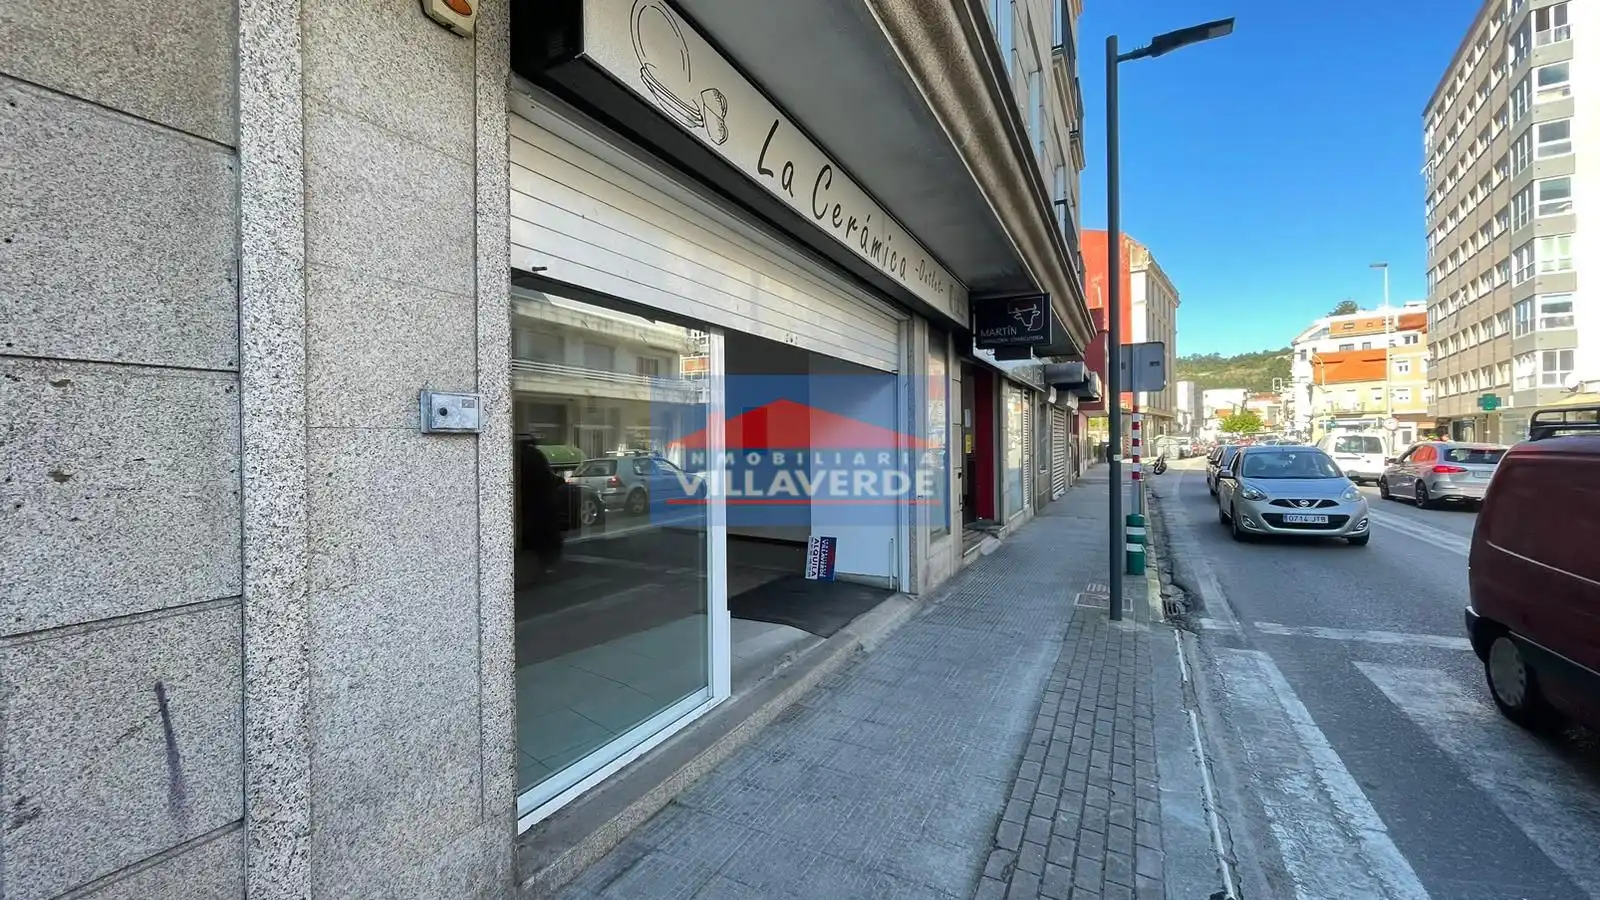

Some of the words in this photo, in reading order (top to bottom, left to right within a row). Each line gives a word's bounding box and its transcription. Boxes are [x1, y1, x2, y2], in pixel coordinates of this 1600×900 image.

[757, 119, 794, 198] La
[812, 164, 907, 281] Cerámica
[980, 325, 1017, 337] MARTÍN
[811, 538, 820, 577] ALQUILA
